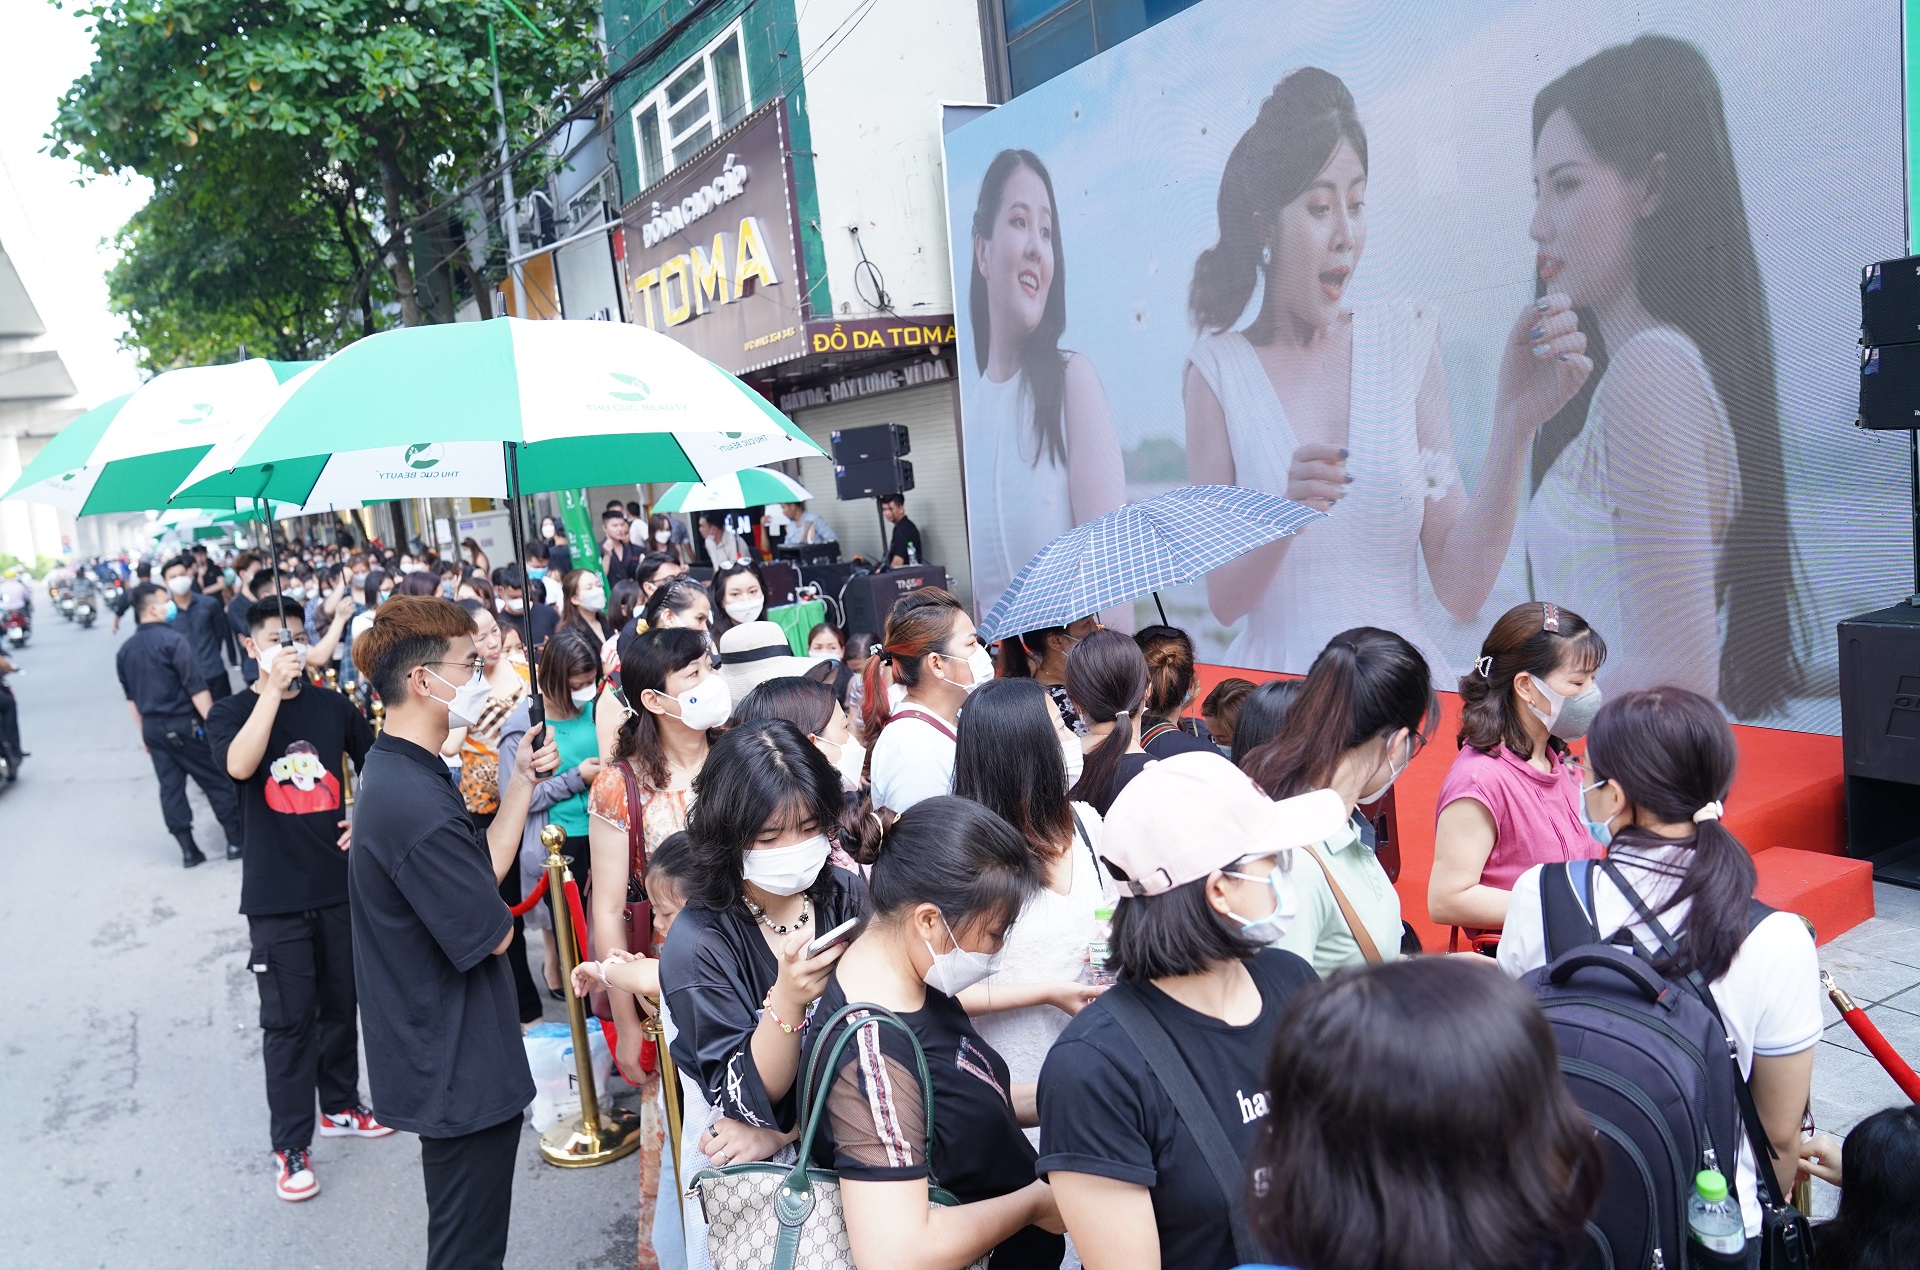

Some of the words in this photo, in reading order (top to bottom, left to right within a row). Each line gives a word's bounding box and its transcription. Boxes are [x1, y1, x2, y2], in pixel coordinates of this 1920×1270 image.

[681, 190, 714, 226] CAO
[634, 216, 778, 331] TOMA
[812, 323, 848, 352] ĐỒ
[852, 329, 886, 349] DA
[887, 325, 956, 347] TOMA
[922, 359, 950, 383] DA
